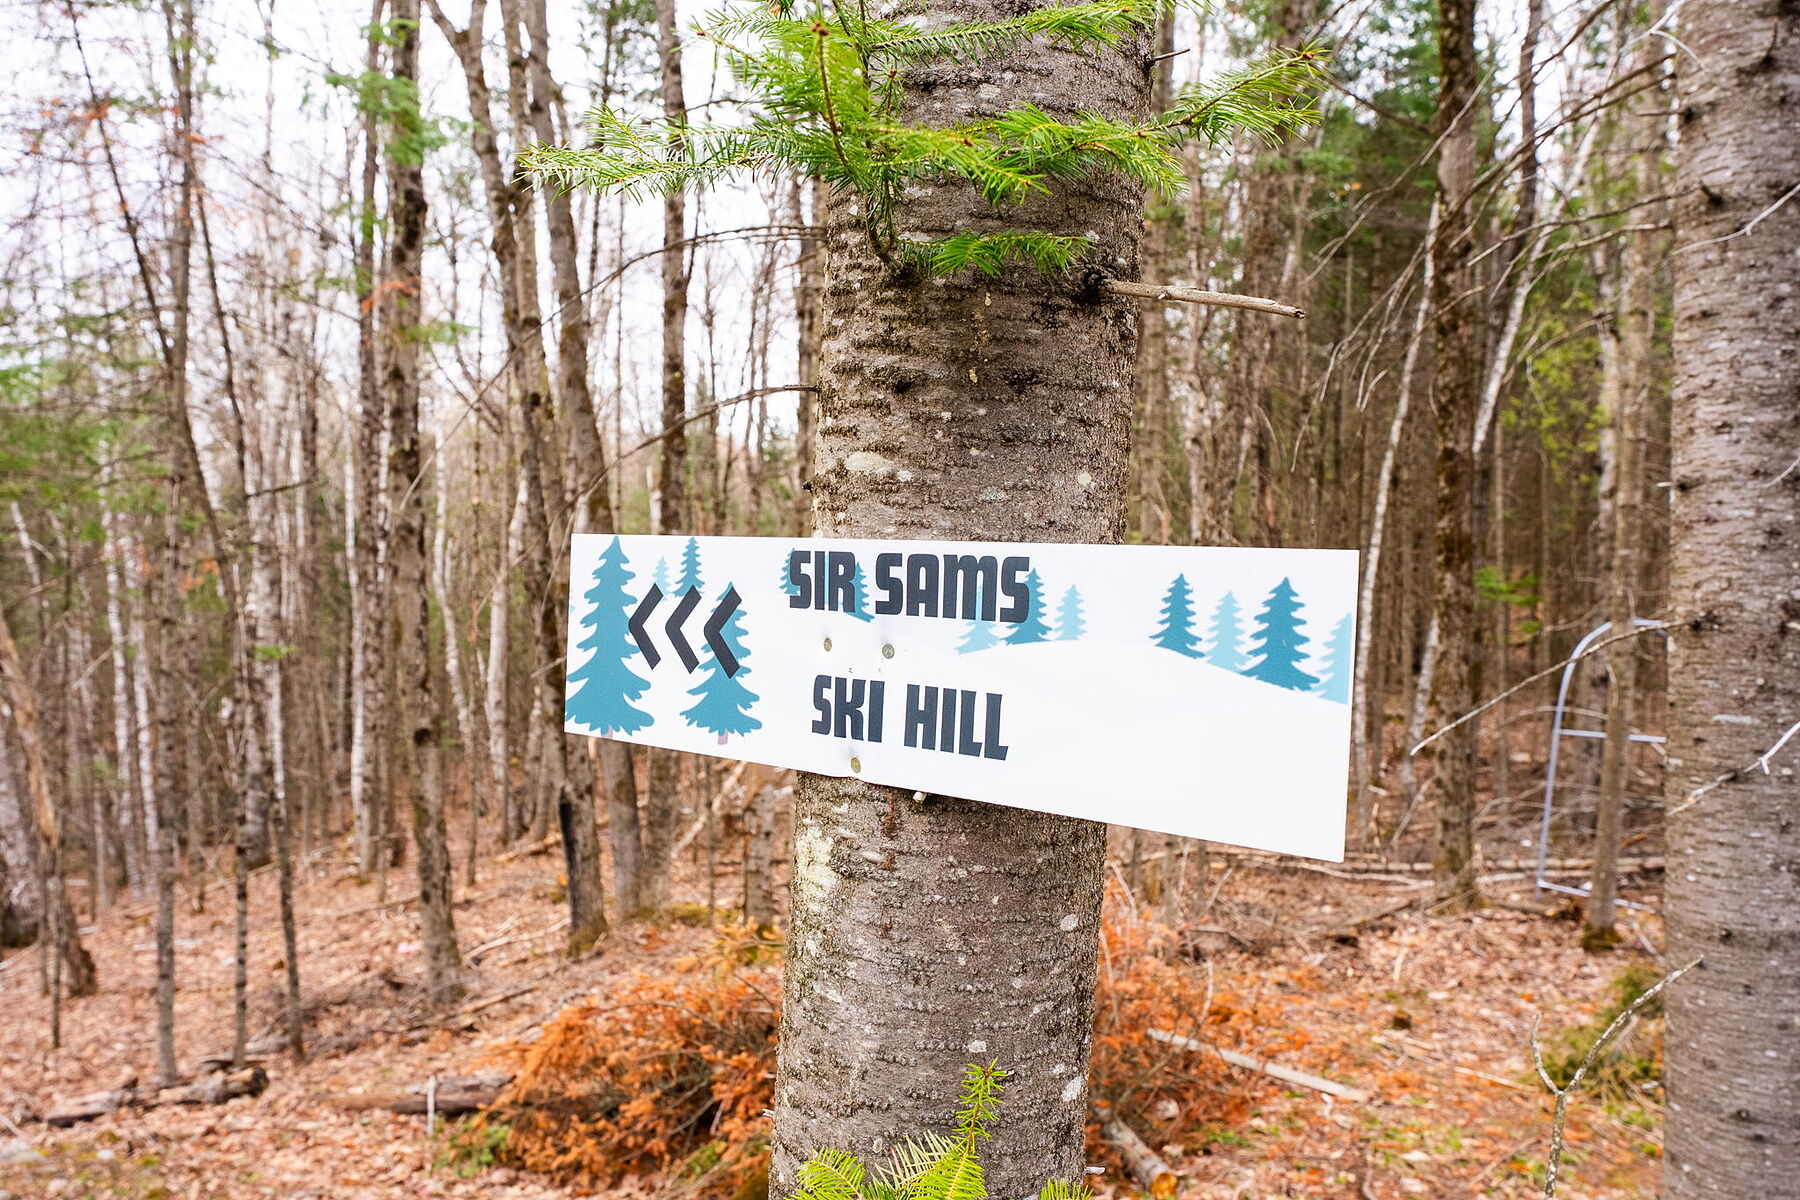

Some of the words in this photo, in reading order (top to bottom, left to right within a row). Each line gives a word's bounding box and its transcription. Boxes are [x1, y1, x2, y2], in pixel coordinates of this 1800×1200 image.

[789, 550, 856, 613] SIR
[875, 552, 1031, 624] SAMS
[811, 674, 885, 743] SKI
[904, 683, 1009, 761] HILL
